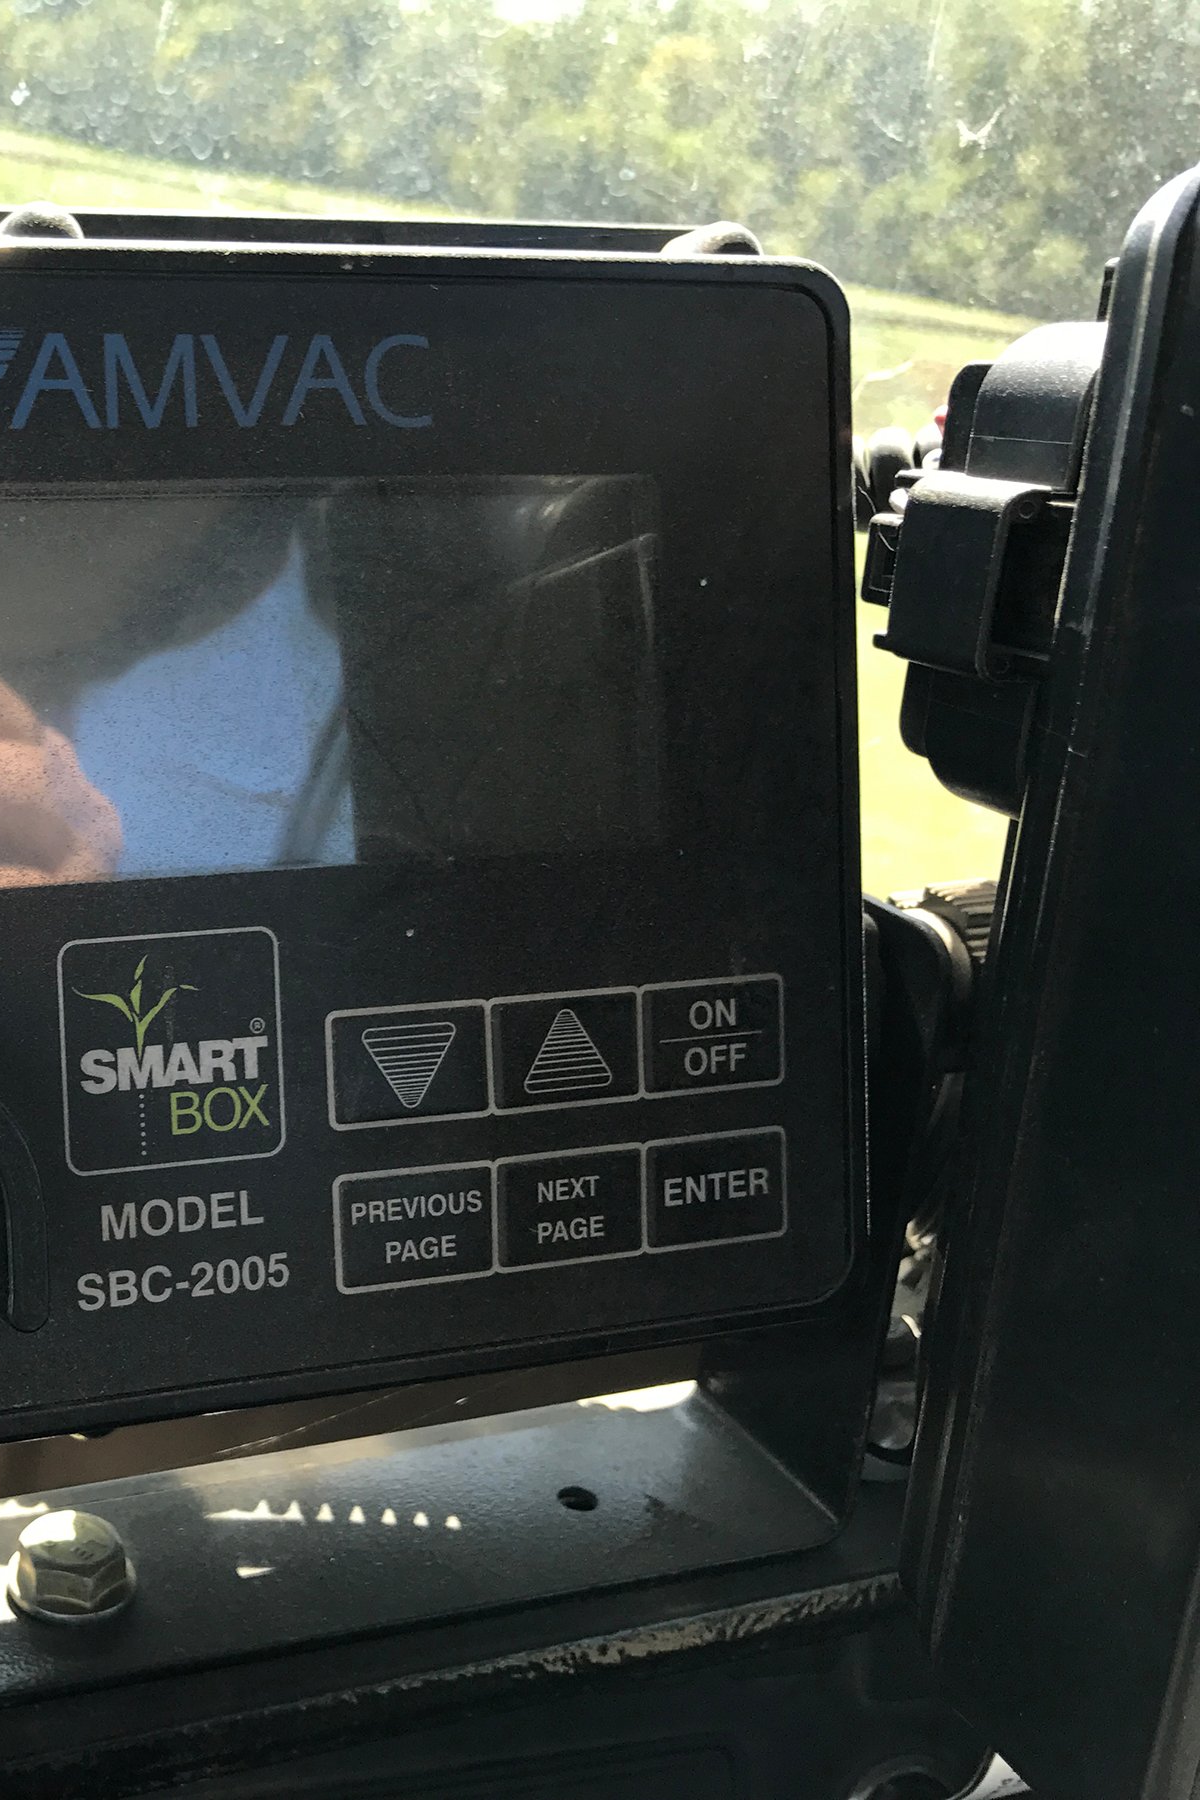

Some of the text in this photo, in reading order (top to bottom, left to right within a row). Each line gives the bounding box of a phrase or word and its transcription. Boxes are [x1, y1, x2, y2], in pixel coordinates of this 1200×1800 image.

[9, 332, 433, 429] AMVAC
[688, 999, 737, 1030] ON
[79, 1035, 269, 1095] SMART
[683, 1043, 748, 1077] OFF
[169, 1083, 270, 1136] BOX
[536, 1175, 600, 1204] NEXT
[663, 1166, 770, 1208] ENTER
[100, 1190, 264, 1242] MODEL
[350, 1189, 483, 1226] PREVIOUS
[384, 1234, 458, 1264] PAGE
[536, 1215, 606, 1244] PAGE
[76, 1252, 290, 1312] SBC-2005
